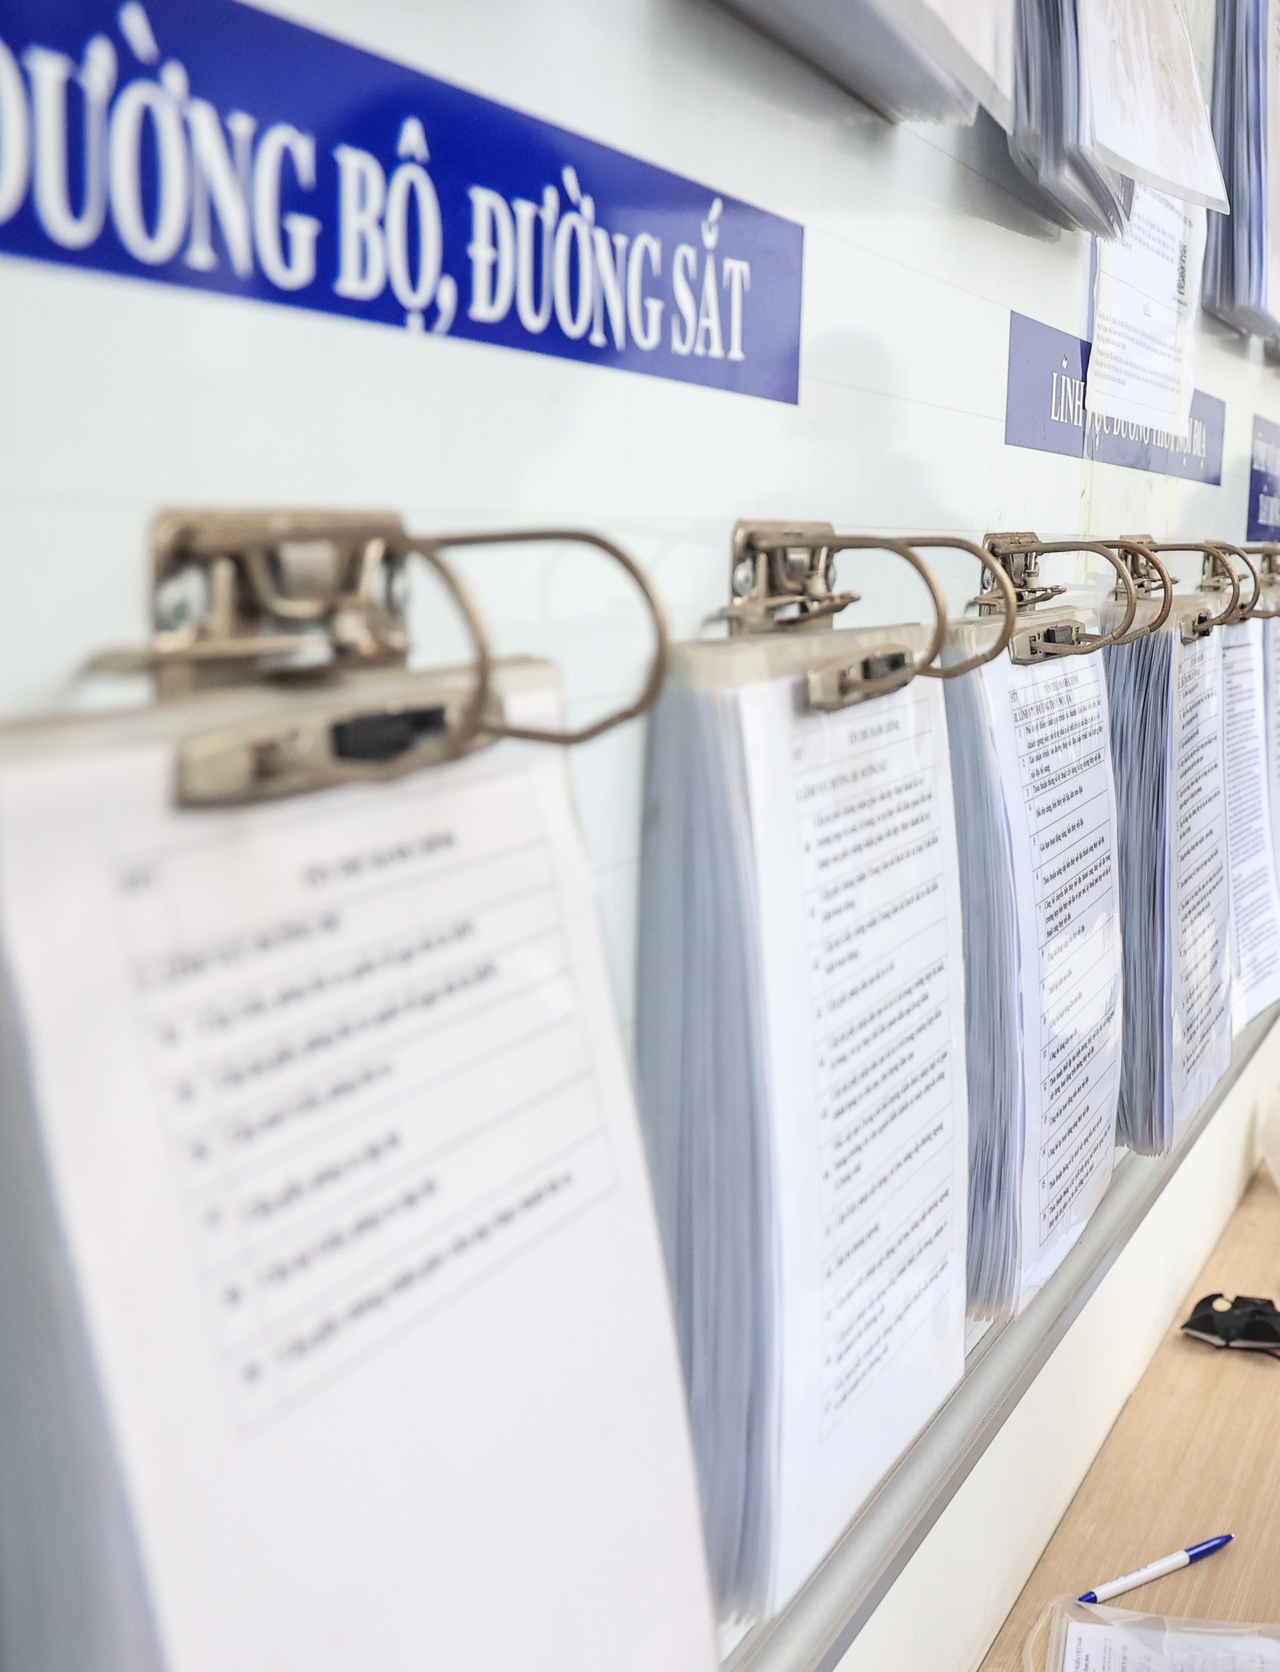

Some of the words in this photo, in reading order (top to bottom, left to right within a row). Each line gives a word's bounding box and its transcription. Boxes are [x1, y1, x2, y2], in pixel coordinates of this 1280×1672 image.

[332, 117, 458, 335] BỘ,
[467, 166, 665, 353] ĐƯỜNG
[671, 197, 752, 362] SẮT
[1050, 357, 1085, 428] LĨNH
